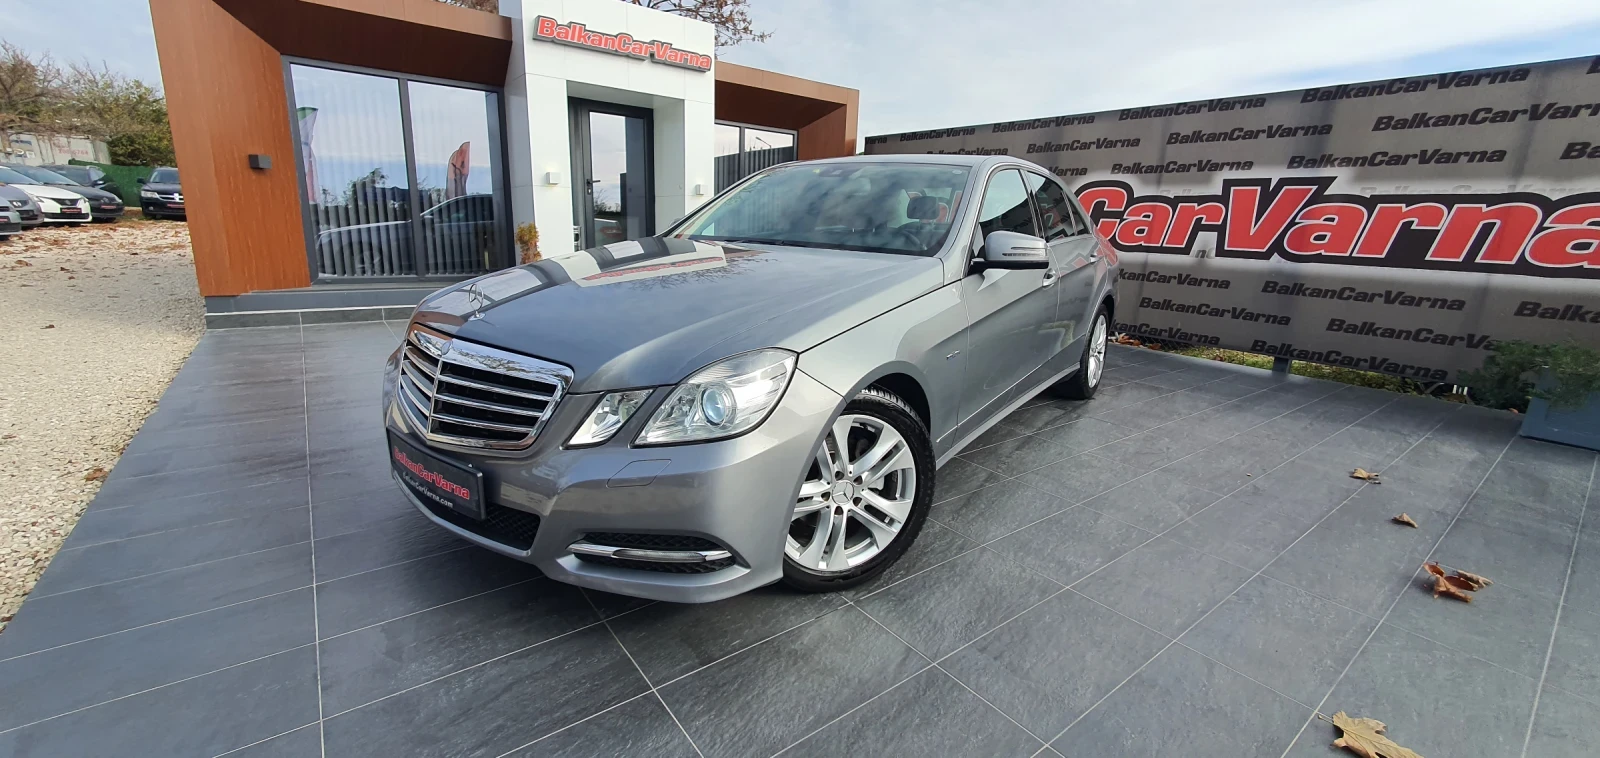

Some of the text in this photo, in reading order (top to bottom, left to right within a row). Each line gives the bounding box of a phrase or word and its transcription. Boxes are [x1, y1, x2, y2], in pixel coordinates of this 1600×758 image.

[537, 16, 711, 69] BalkanCarVarna
[1300, 67, 1531, 104] BalkanCarVarna
[1118, 97, 1266, 121] BalkanCarVarna
[900, 127, 976, 142] BalkanCarVarna
[992, 114, 1095, 134] BalkanCarVarna
[1166, 123, 1333, 146] BalkanCarVarna
[926, 147, 1009, 155] CarVarna
[1026, 135, 1140, 154] BalkanCarVarna
[1110, 160, 1254, 175] BalkanCarVarna
[1287, 149, 1507, 170] BalkanCarVarna
[1261, 280, 1466, 311] BalkanCarVarna
[1139, 296, 1292, 326] BalkanCarVarna
[1250, 338, 1449, 381] BalkanCarVarna
[393, 445, 471, 500] BalkanCarVarna
